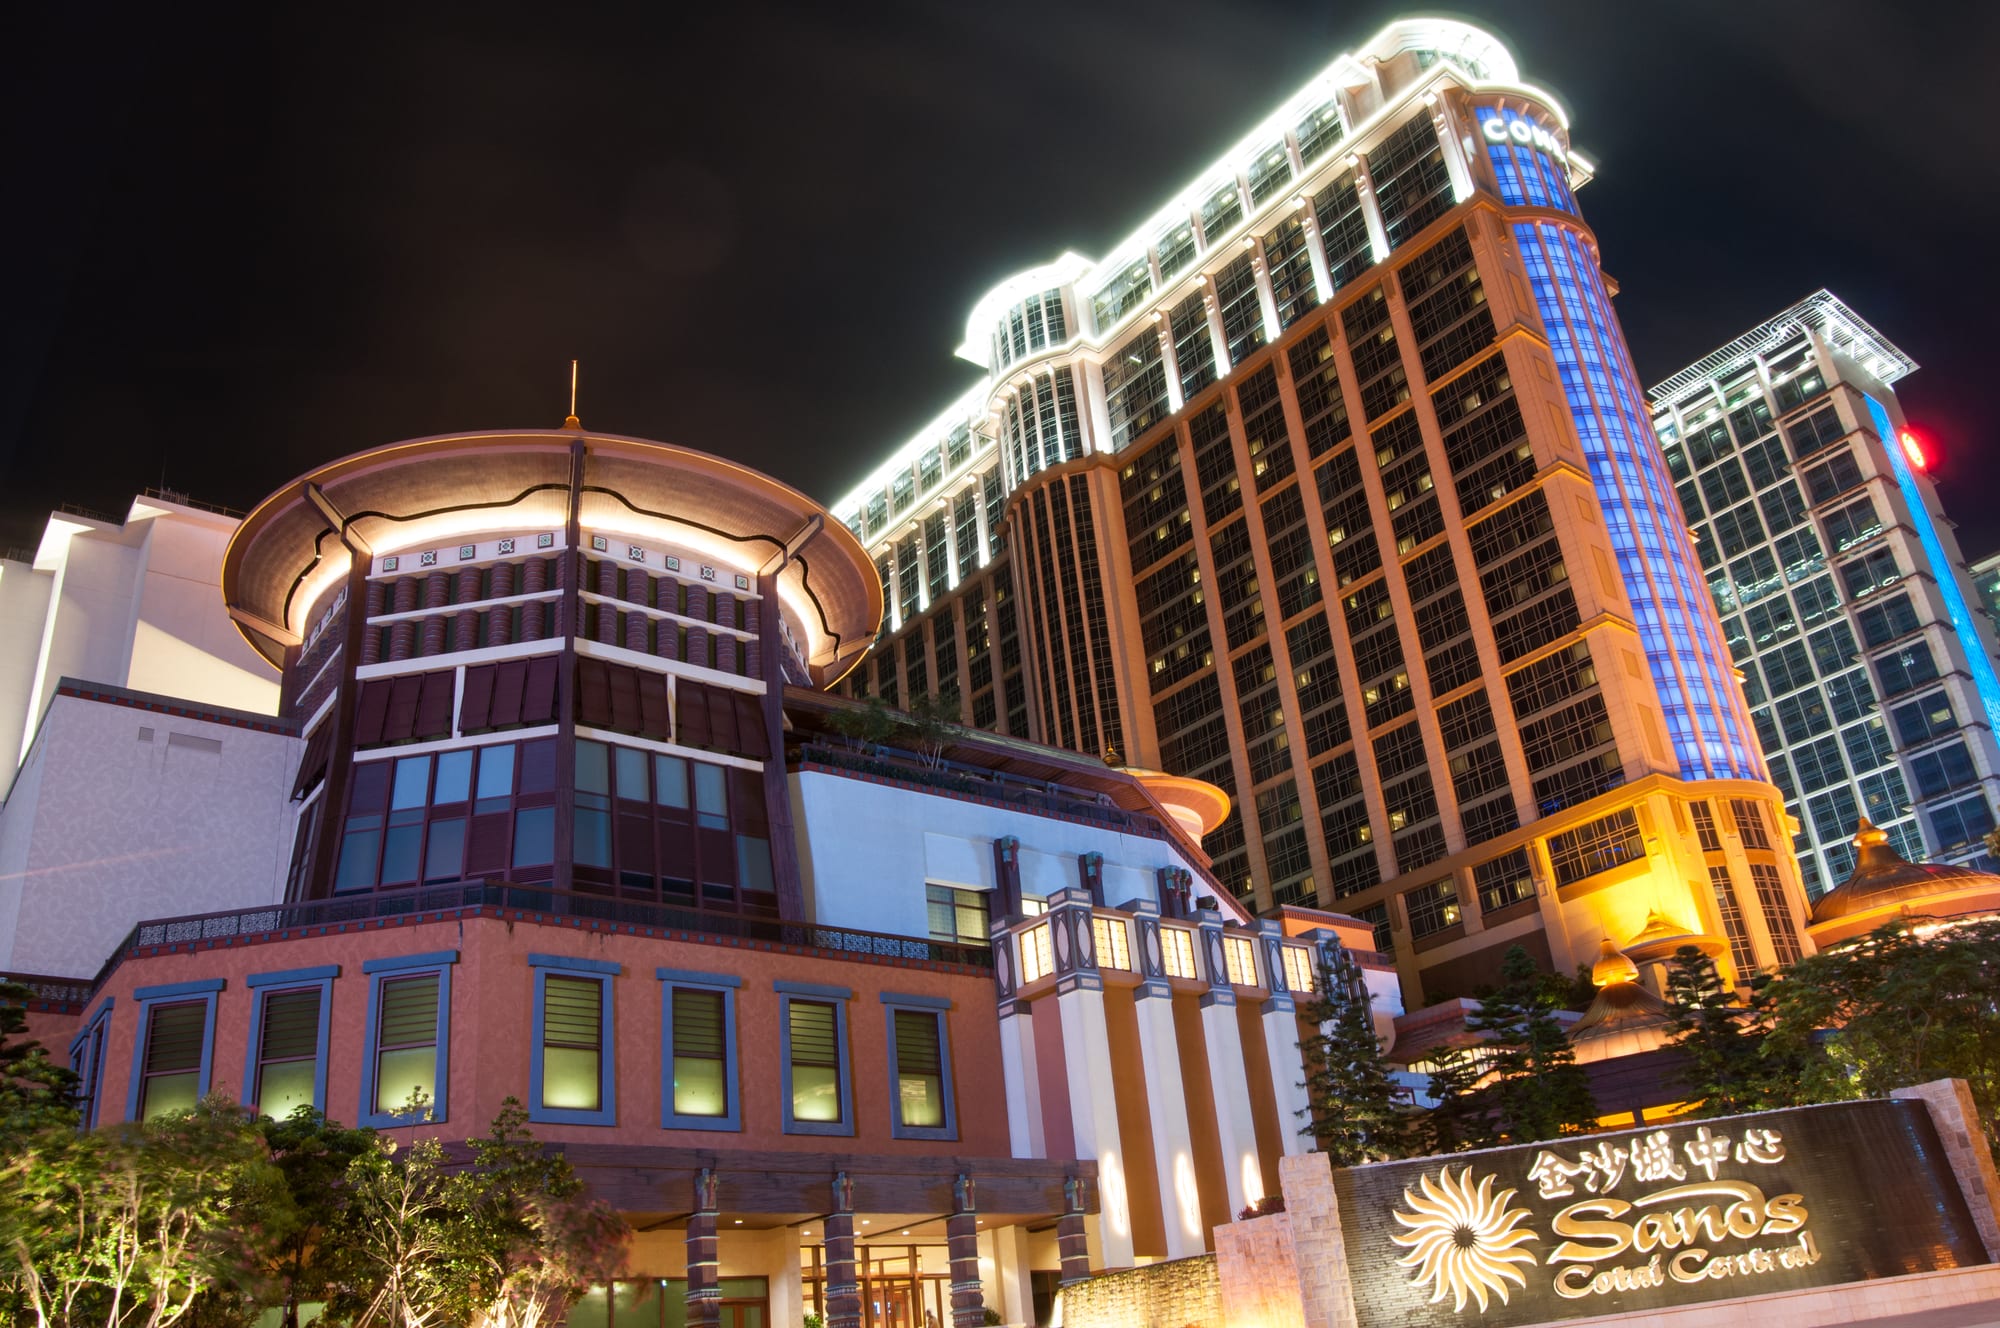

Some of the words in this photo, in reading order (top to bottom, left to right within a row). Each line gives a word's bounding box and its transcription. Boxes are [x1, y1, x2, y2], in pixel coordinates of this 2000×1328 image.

[1528, 1126, 1787, 1199] 金沙城中心
[1547, 1181, 1808, 1265] Sands
[1554, 1253, 1665, 1299] Cotai
[1669, 1231, 1821, 1283] Central
